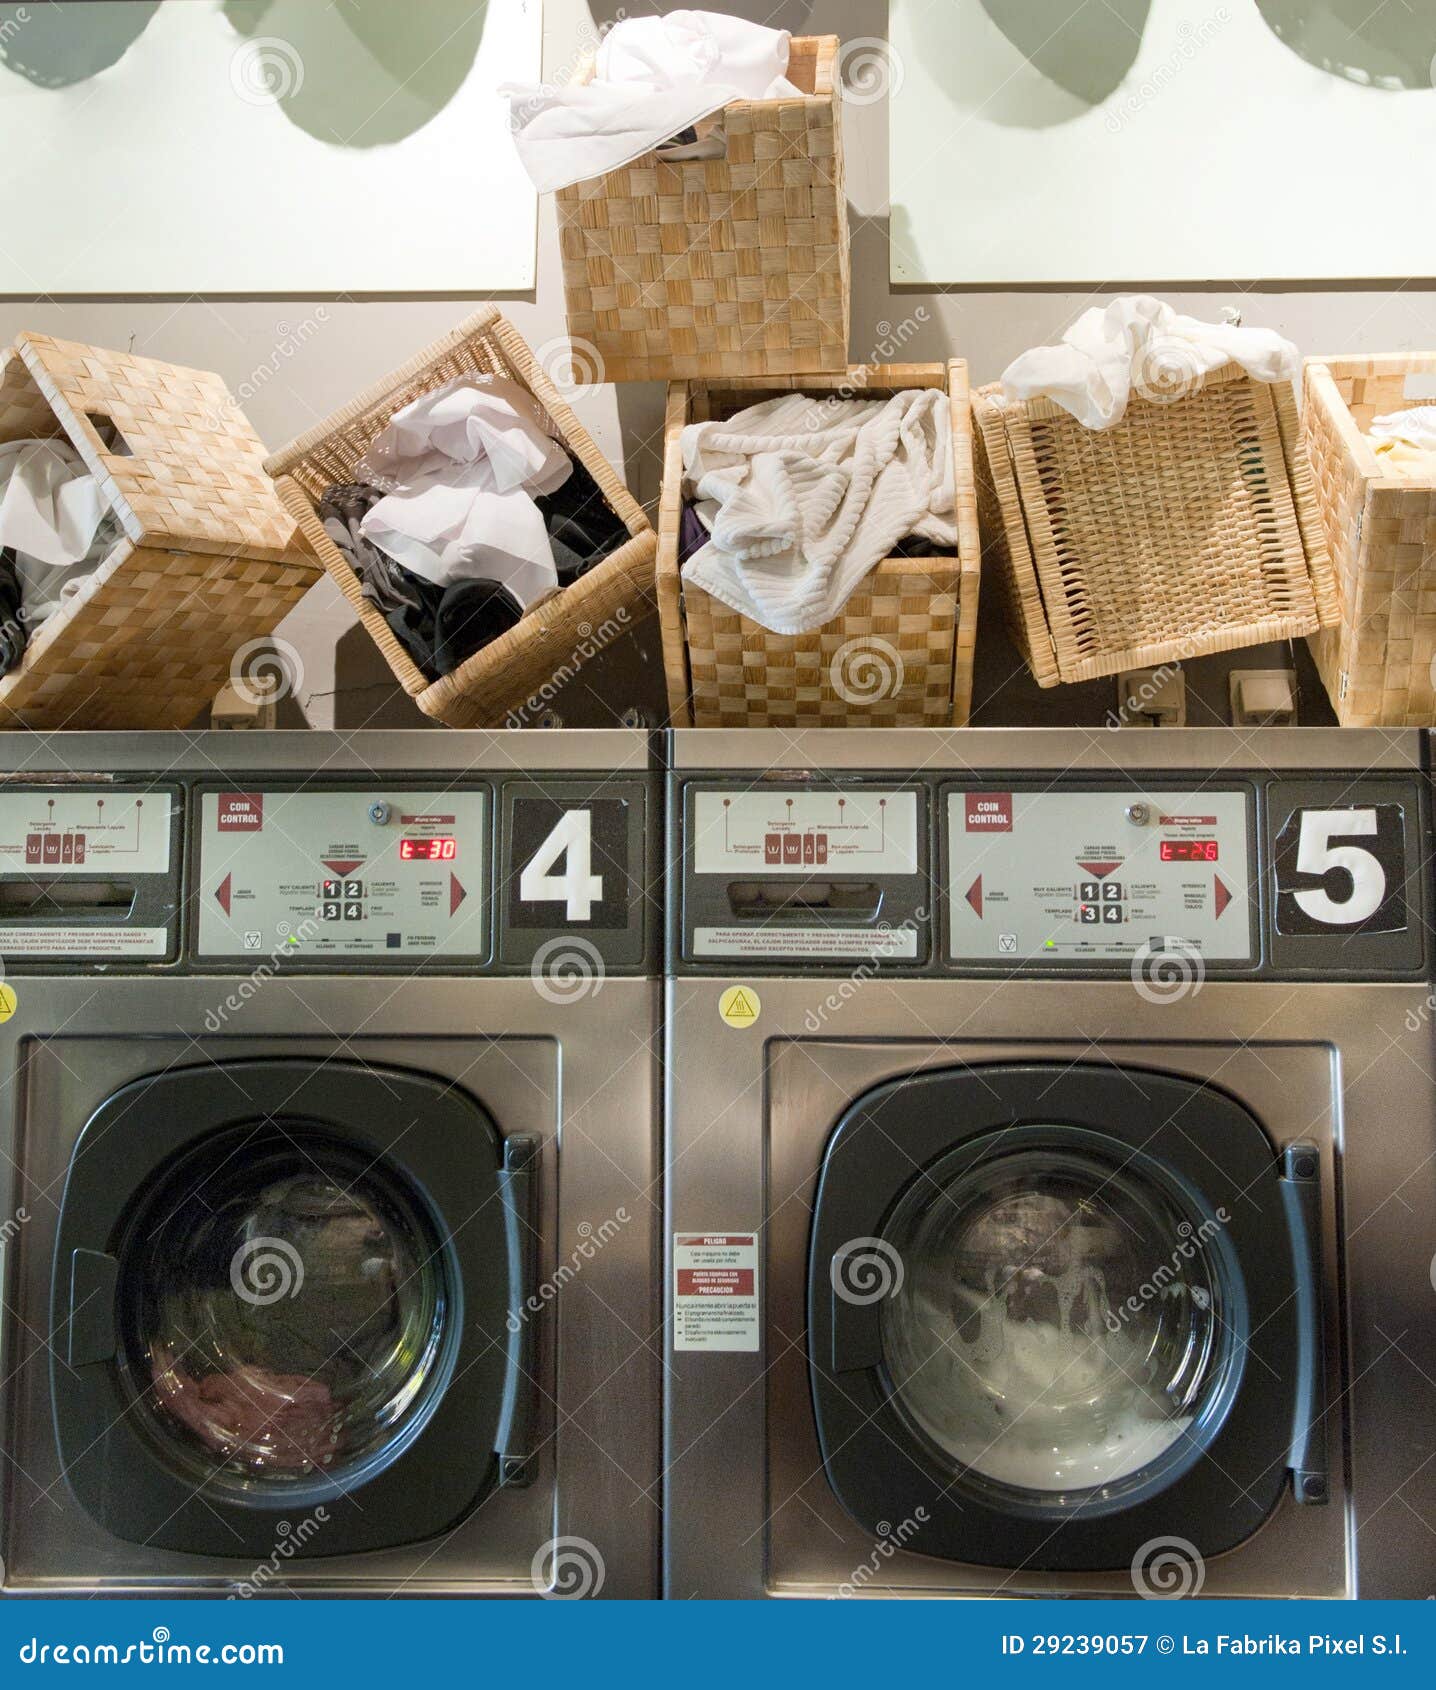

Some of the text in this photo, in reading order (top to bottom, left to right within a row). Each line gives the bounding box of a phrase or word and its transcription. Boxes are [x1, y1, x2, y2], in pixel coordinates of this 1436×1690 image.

[229, 802, 250, 812] COIN
[977, 802, 999, 812] COIN
[221, 814, 259, 824] CONTROL
[968, 814, 1009, 824] CONTROL
[521, 810, 602, 920] 4
[1293, 809, 1386, 924] 5
[327, 883, 335, 896] 1
[348, 883, 359, 896] 2
[1084, 885, 1093, 899] 1
[1106, 885, 1118, 899] 2
[327, 904, 337, 918] 3
[347, 904, 358, 918] 4
[1085, 907, 1095, 920] 3
[1106, 907, 1118, 920] 4
